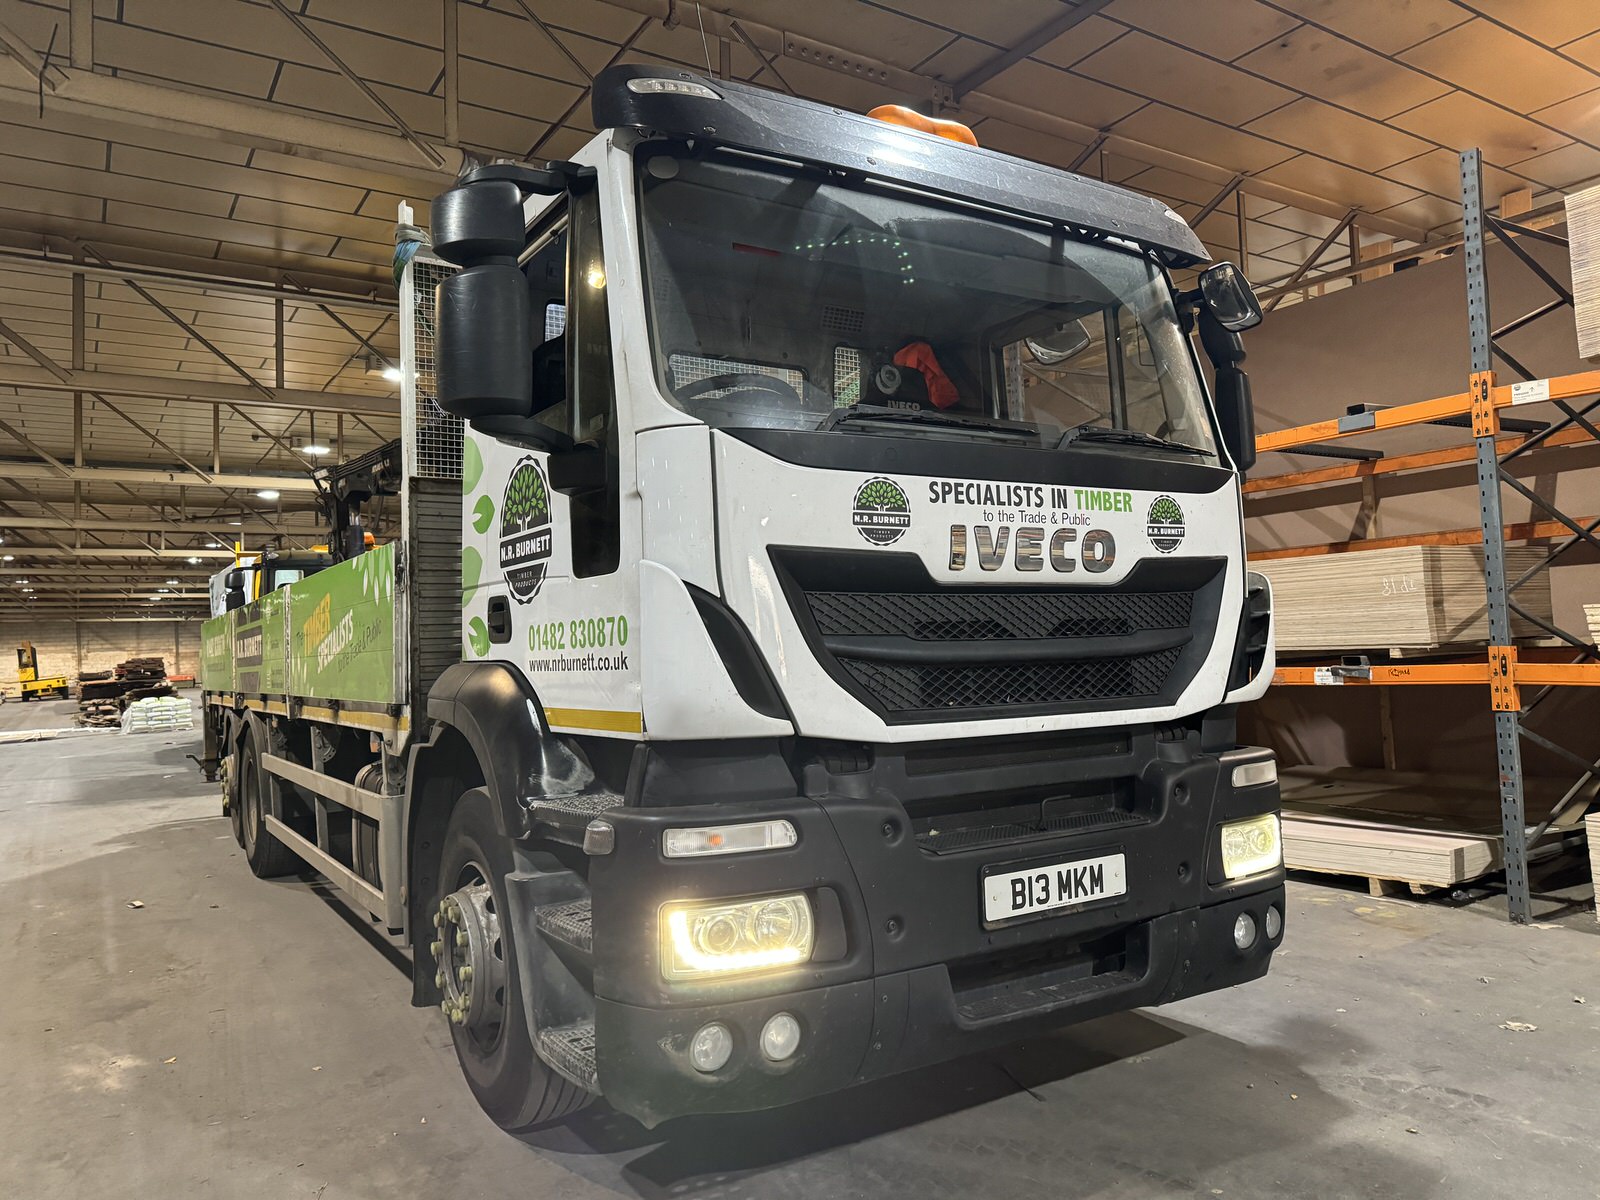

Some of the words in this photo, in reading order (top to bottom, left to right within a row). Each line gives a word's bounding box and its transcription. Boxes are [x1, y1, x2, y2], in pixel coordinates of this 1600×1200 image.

[888, 400, 920, 411] IVECO
[929, 481, 1044, 508] SPECIALISTS
[1051, 487, 1068, 509] IN
[1074, 489, 1133, 512] TIMBER
[854, 514, 871, 523] N.R.
[872, 515, 909, 525] BURNETT
[983, 509, 994, 522] to
[998, 509, 1015, 523] the
[1018, 510, 1047, 524] Trade
[1050, 511, 1058, 525] &
[1061, 512, 1091, 526] Public
[1160, 527, 1185, 535] BURNETT
[501, 545, 515, 562] N.R.
[515, 534, 551, 558] BURNETT
[949, 524, 1117, 574] IVECO
[304, 592, 331, 657] TIMBER
[528, 621, 565, 651] 01482
[569, 615, 629, 649] 830870
[317, 608, 354, 675] SPECIALISTS
[528, 651, 629, 672] www.nrburnett.co.uk
[1010, 873, 1051, 911] B13
[1057, 863, 1105, 902] MKM
